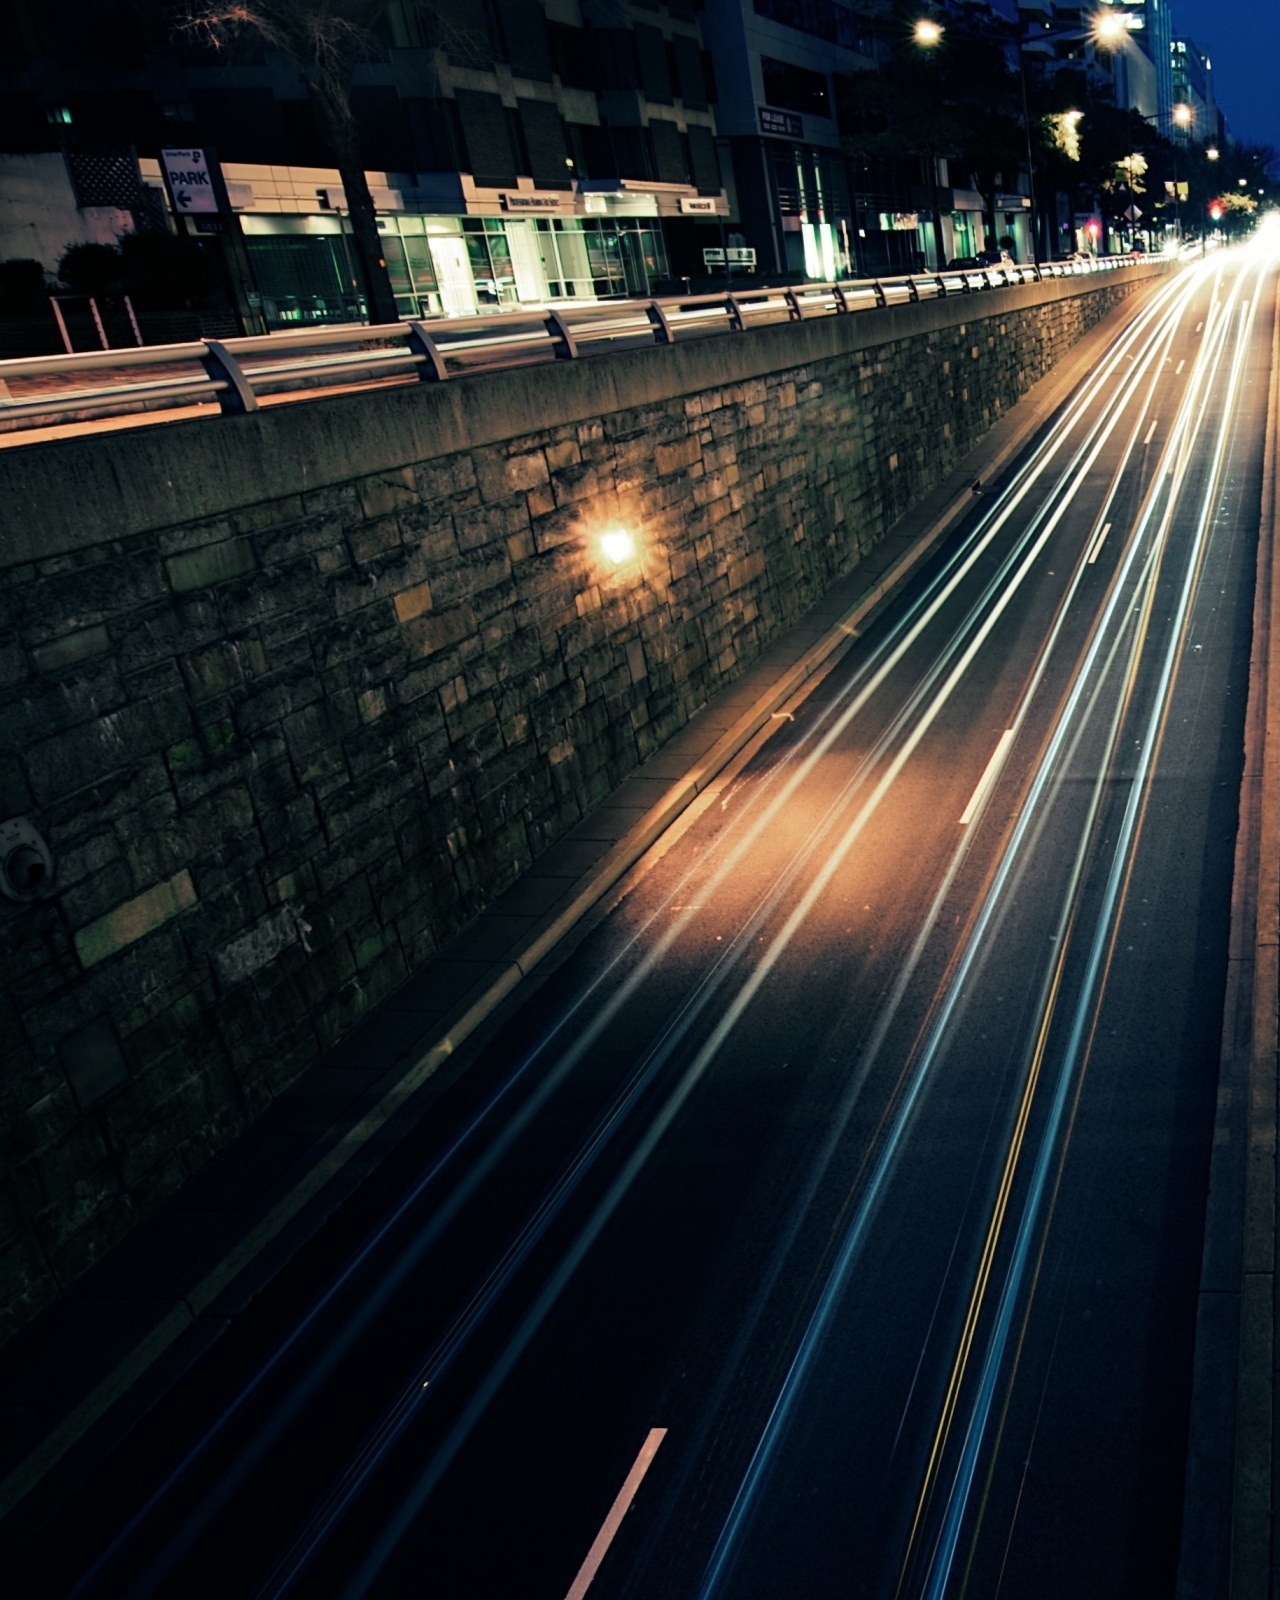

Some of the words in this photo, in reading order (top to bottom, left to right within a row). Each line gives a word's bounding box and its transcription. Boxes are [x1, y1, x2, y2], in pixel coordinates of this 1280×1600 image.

[762, 111, 772, 121] FOR
[772, 113, 785, 124] LEASE
[169, 172, 210, 185] PARK
[202, 223, 223, 231] DELI
